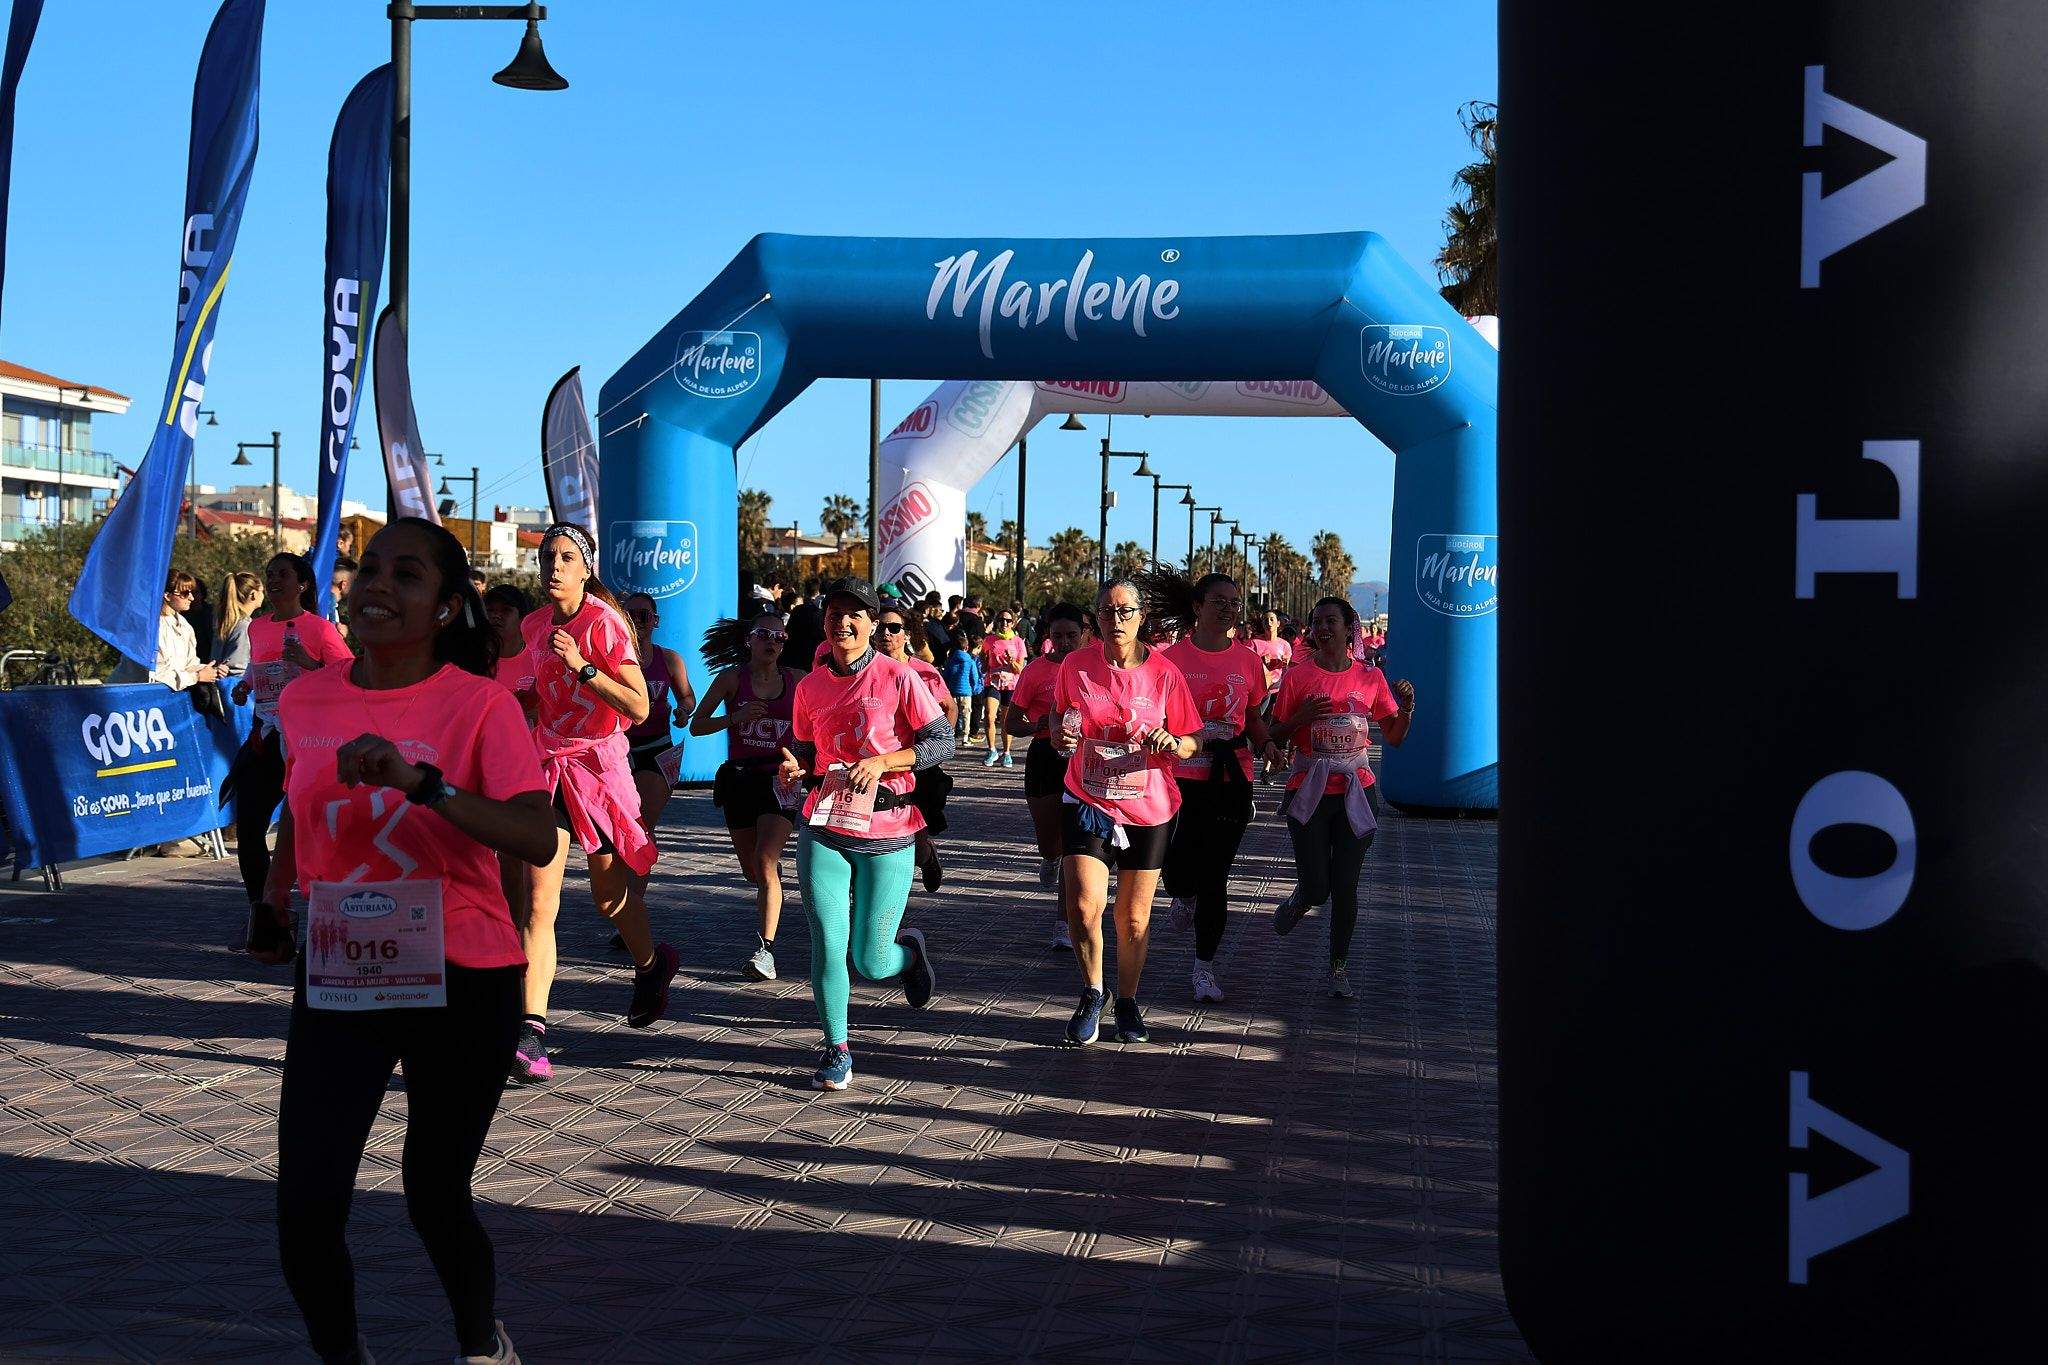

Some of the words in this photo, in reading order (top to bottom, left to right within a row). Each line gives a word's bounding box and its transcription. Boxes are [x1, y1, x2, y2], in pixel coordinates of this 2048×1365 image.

[680, 345, 755, 380] Marlene
[1367, 339, 1445, 377] Marlene
[698, 386, 710, 395] DE
[710, 387, 726, 395] LOS
[726, 379, 749, 393] ALPES
[1372, 375, 1387, 387] HIJA
[1388, 383, 1399, 391] DE
[1400, 384, 1415, 392] LOS
[1416, 375, 1440, 390] ALPES
[879, 490, 932, 555] OSMO
[614, 538, 692, 578] Marlene
[643, 587, 660, 595] LOS
[660, 577, 686, 593] ALPES
[1425, 591, 1441, 607] HIJA
[1442, 601, 1455, 611] DE
[1455, 604, 1473, 612] LOS
[81, 707, 175, 767] GOYA
[1331, 735, 1352, 743] 016
[1102, 767, 1127, 778] 016
[100, 793, 130, 814] GOYA
[156, 790, 171, 815] que
[171, 787, 186, 800] ser
[343, 902, 393, 913] ASTURIANA
[345, 940, 400, 961] 016
[356, 965, 383, 976] 1940
[319, 991, 358, 1004] OYSHO
[386, 991, 429, 1002] Santander
